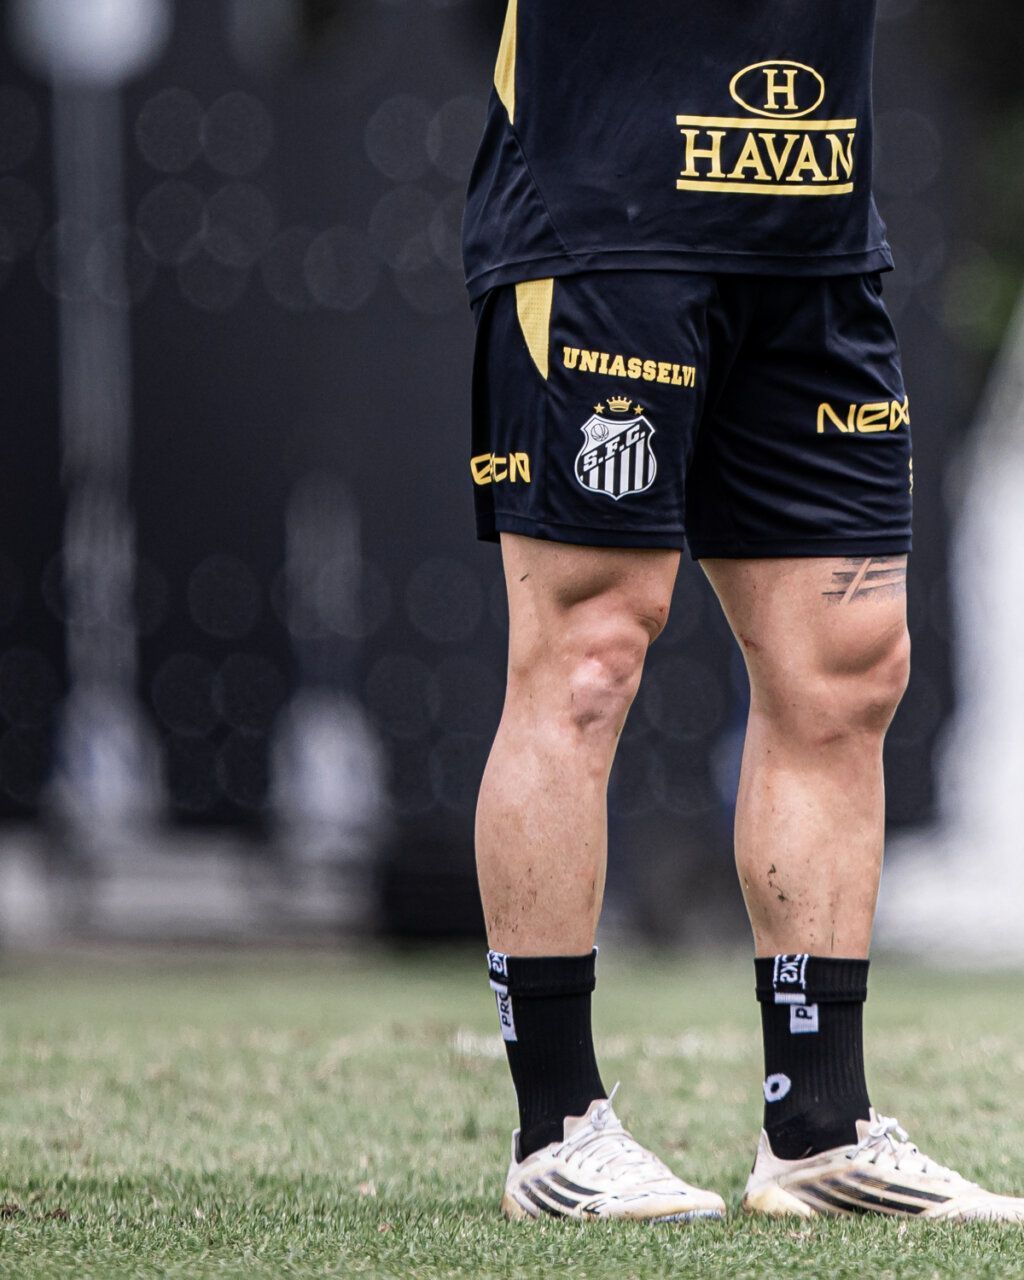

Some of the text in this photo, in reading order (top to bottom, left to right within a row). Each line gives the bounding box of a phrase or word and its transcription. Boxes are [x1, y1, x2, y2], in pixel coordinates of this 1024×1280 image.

[762, 69, 798, 109] H
[680, 129, 855, 181] HAVAN
[563, 346, 696, 388] UNIASSELVI
